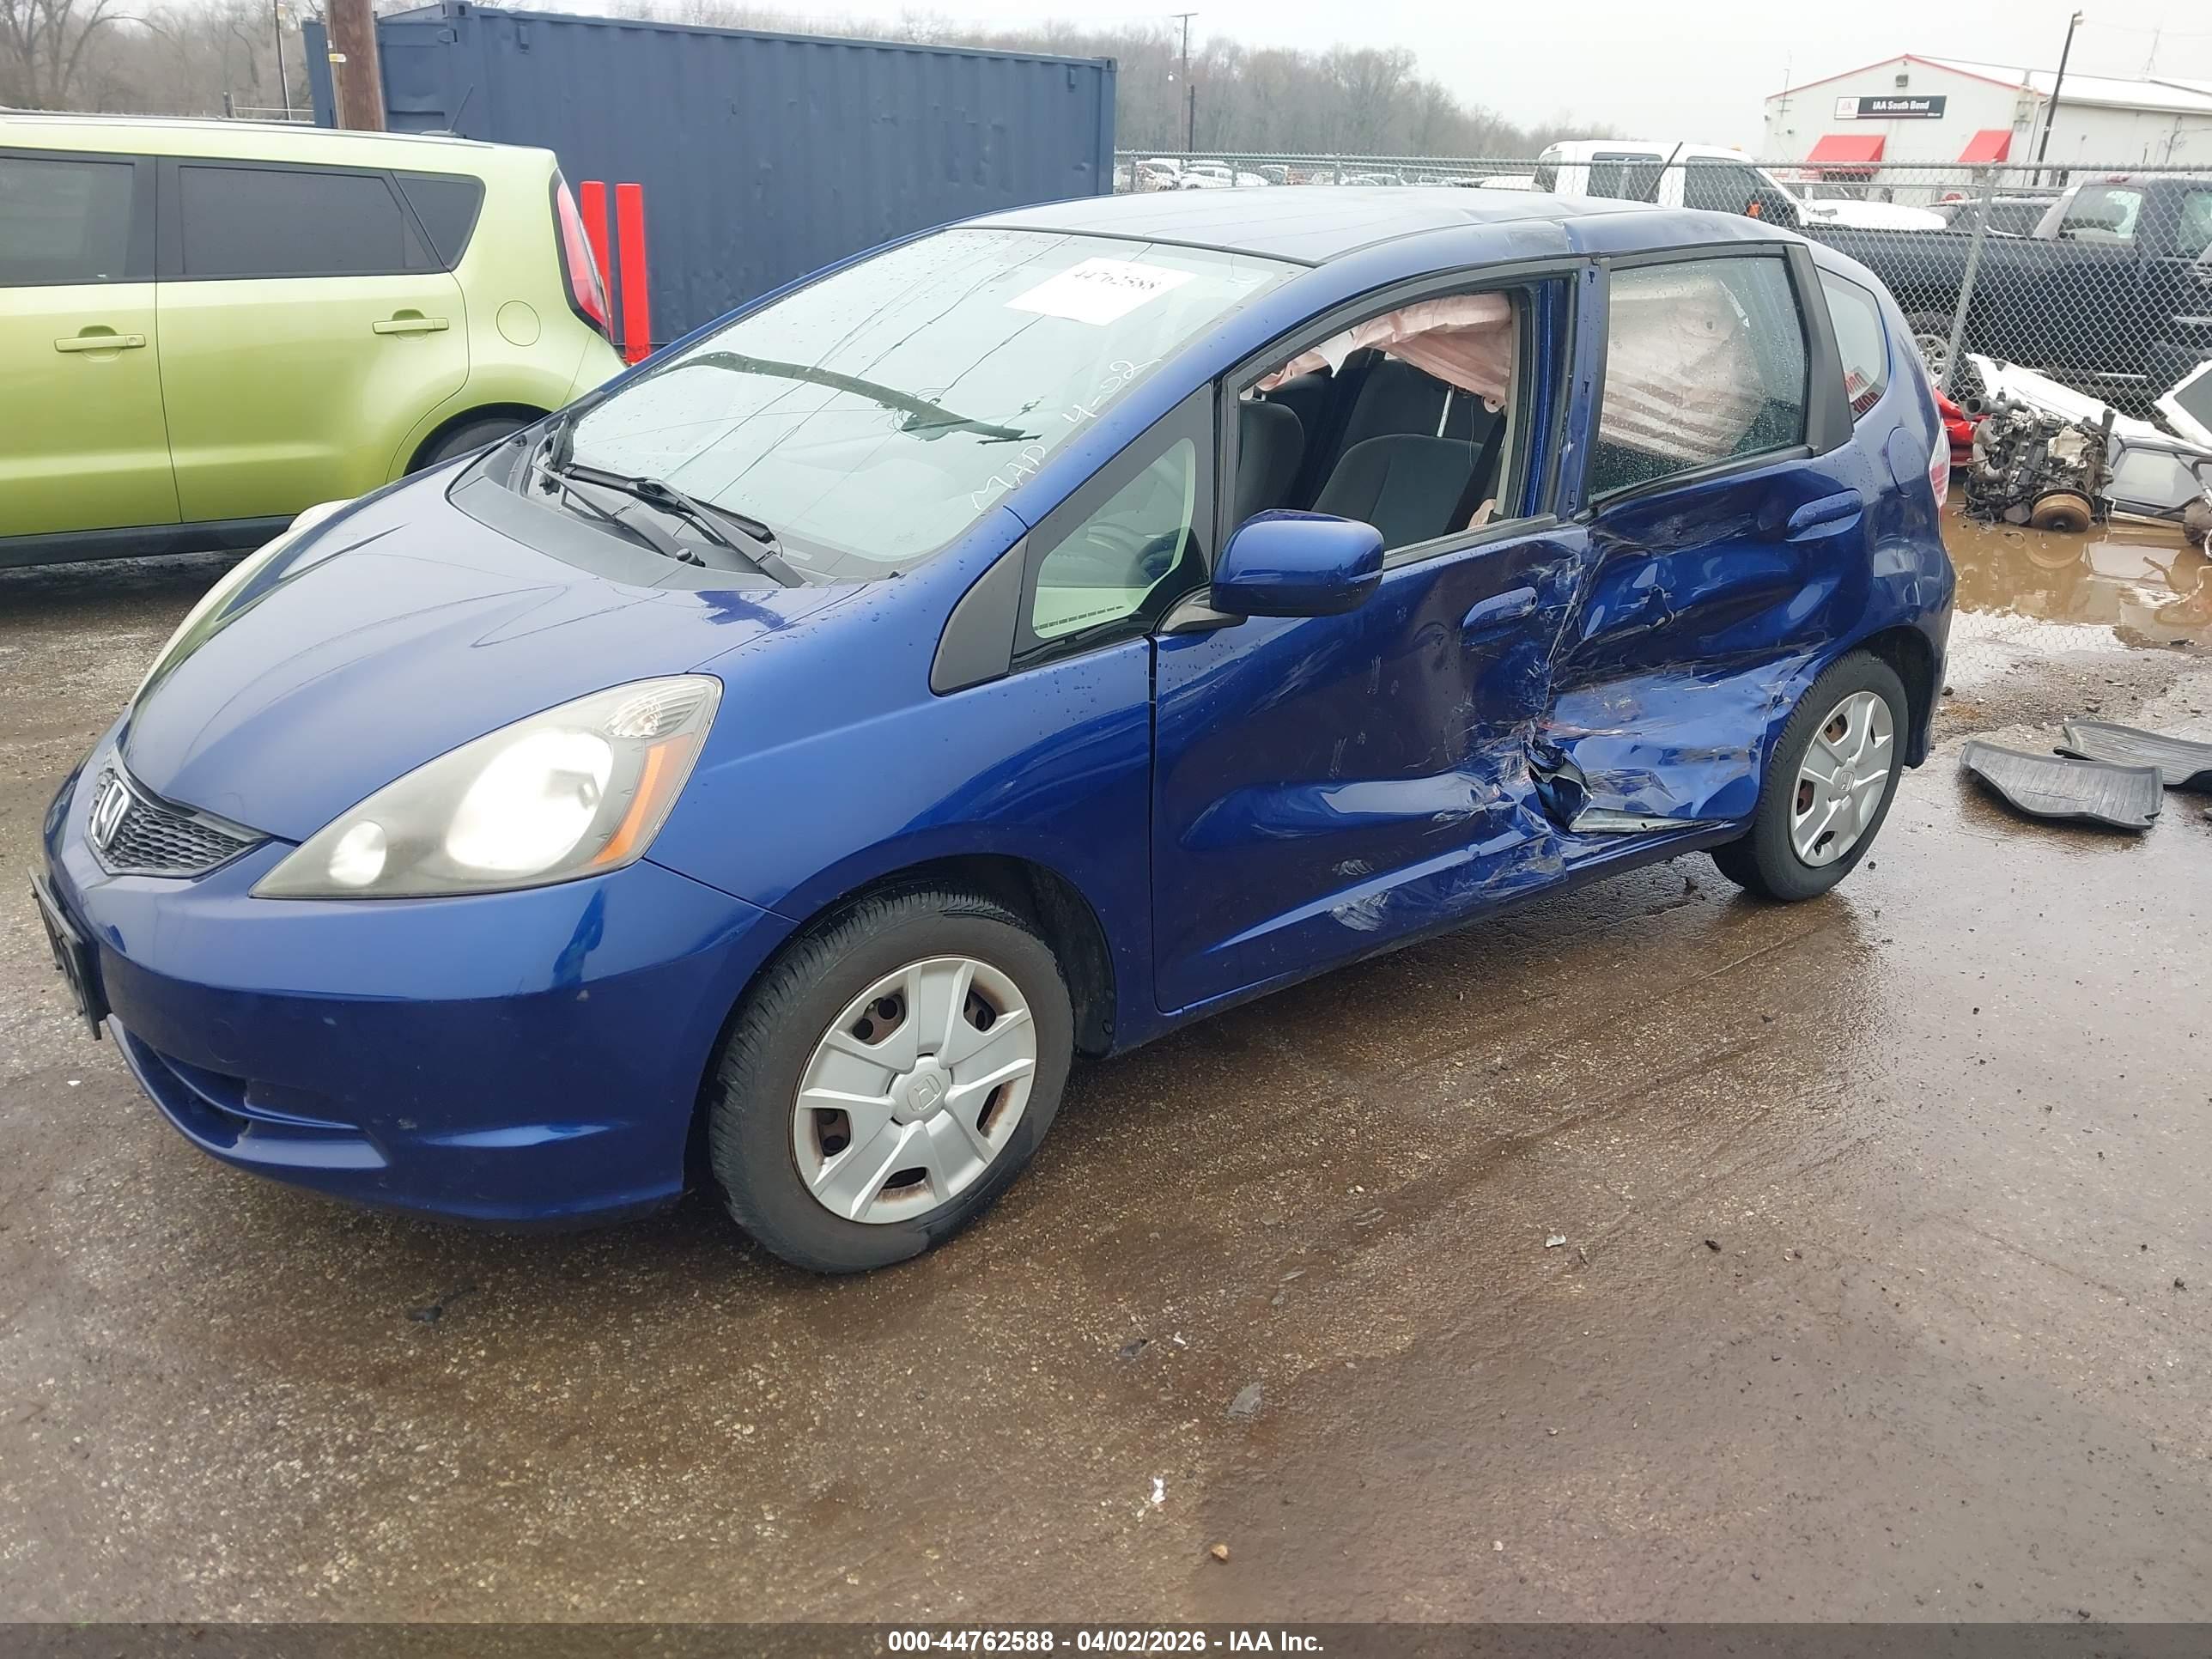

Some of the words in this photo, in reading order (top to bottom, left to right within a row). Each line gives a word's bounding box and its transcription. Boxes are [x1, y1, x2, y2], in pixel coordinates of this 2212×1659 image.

[1872, 100, 1887, 110] IAA
[1887, 100, 1909, 110] South
[1910, 100, 1929, 110] Bend
